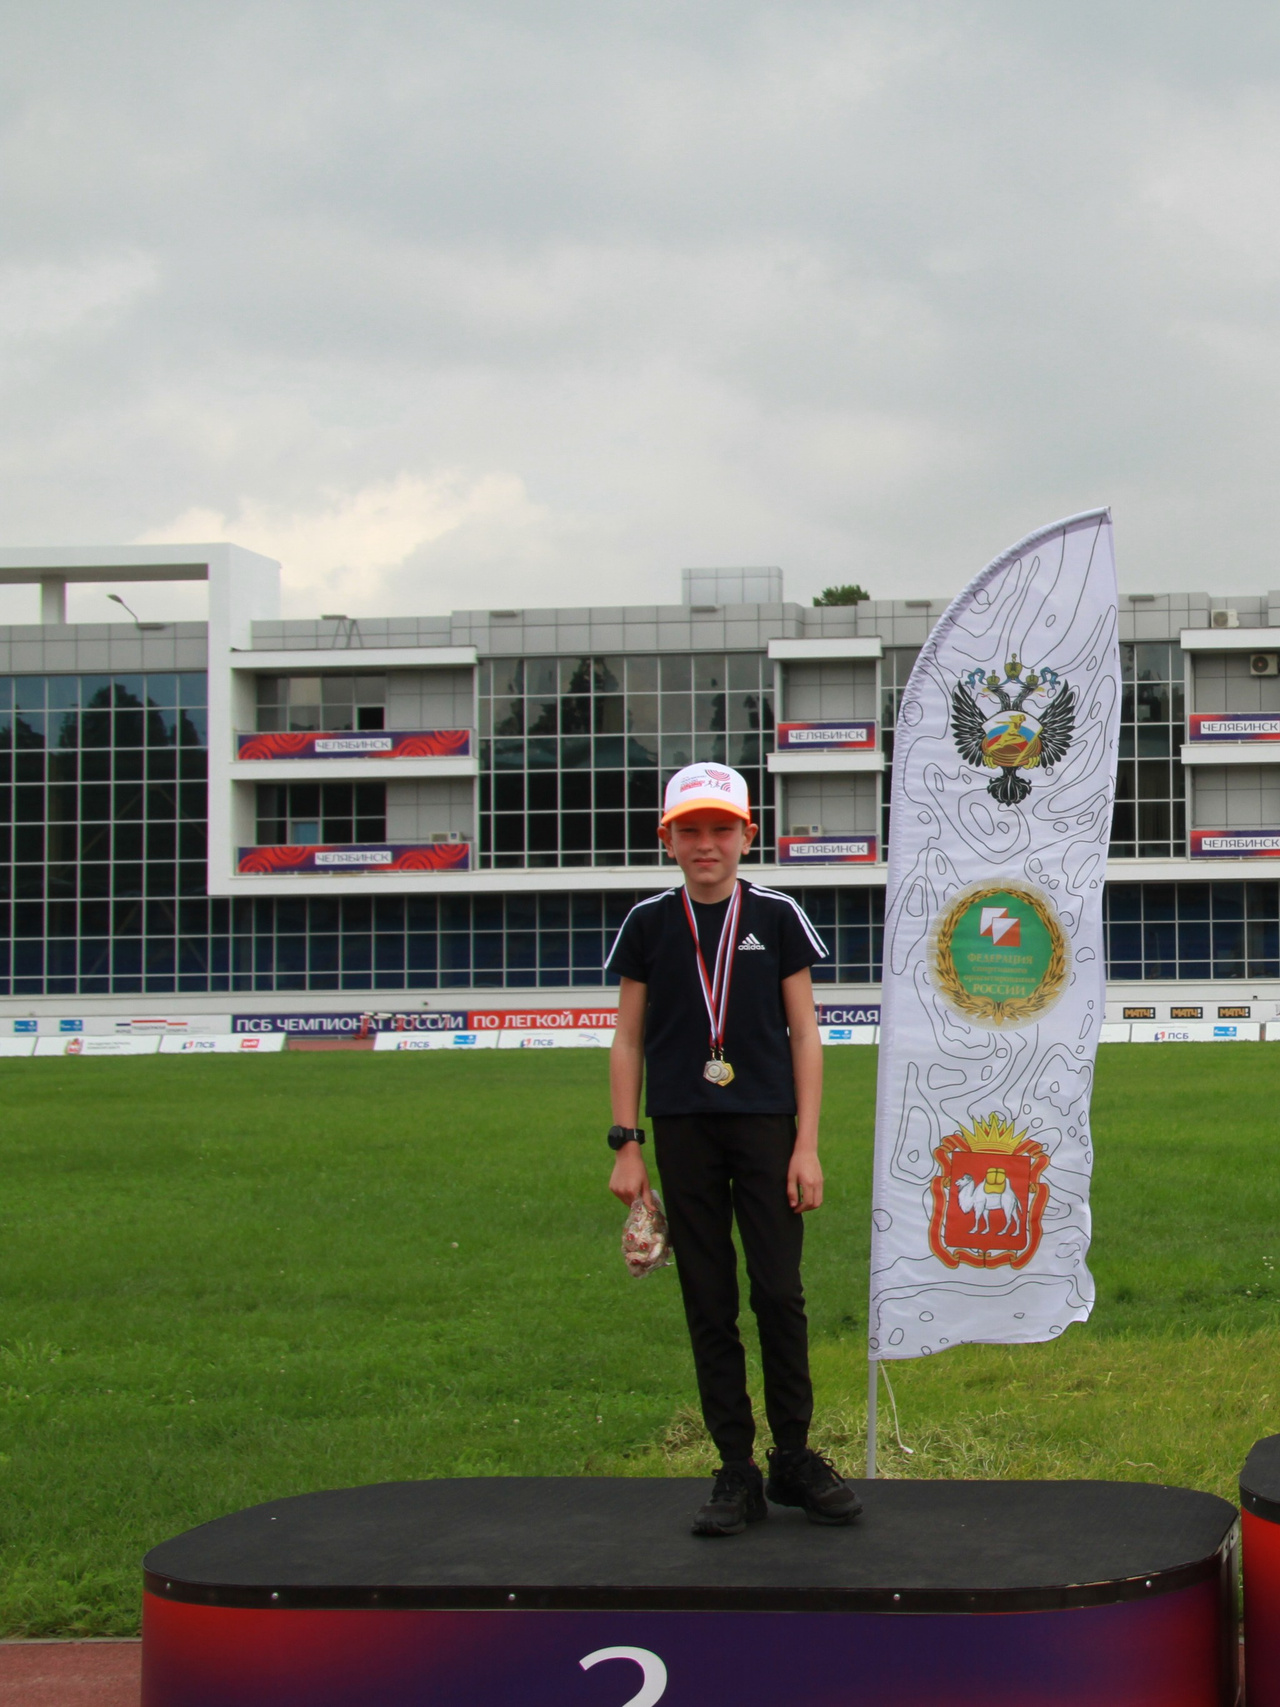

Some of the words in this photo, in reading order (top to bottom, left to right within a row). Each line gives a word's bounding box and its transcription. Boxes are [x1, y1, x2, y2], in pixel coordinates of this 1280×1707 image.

[1202, 722, 1279, 732] ЧЕЛЯБИНСК
[790, 730, 865, 740] ЧЕЛЯБИНСК
[316, 740, 390, 751] ЧЕЛЯБИНСК
[1203, 838, 1280, 849] ЧЕЛЯБИНСК
[791, 844, 866, 854] ЧЕЛЯБИНСК
[316, 853, 390, 864] ЧЕЛЯБИНСК
[972, 984, 1026, 996] РОССИИ
[237, 1019, 273, 1031] ПСБ
[277, 1017, 384, 1031] ЧЕМПИОНАТ
[391, 1015, 464, 1030] РОССИИ
[473, 1015, 499, 1029] ПО
[503, 1011, 573, 1028] ЛЕГКОЙ
[1168, 1032, 1189, 1040] ПСБ
[195, 1041, 215, 1049] ПСБ
[409, 1040, 430, 1049] ПСБ
